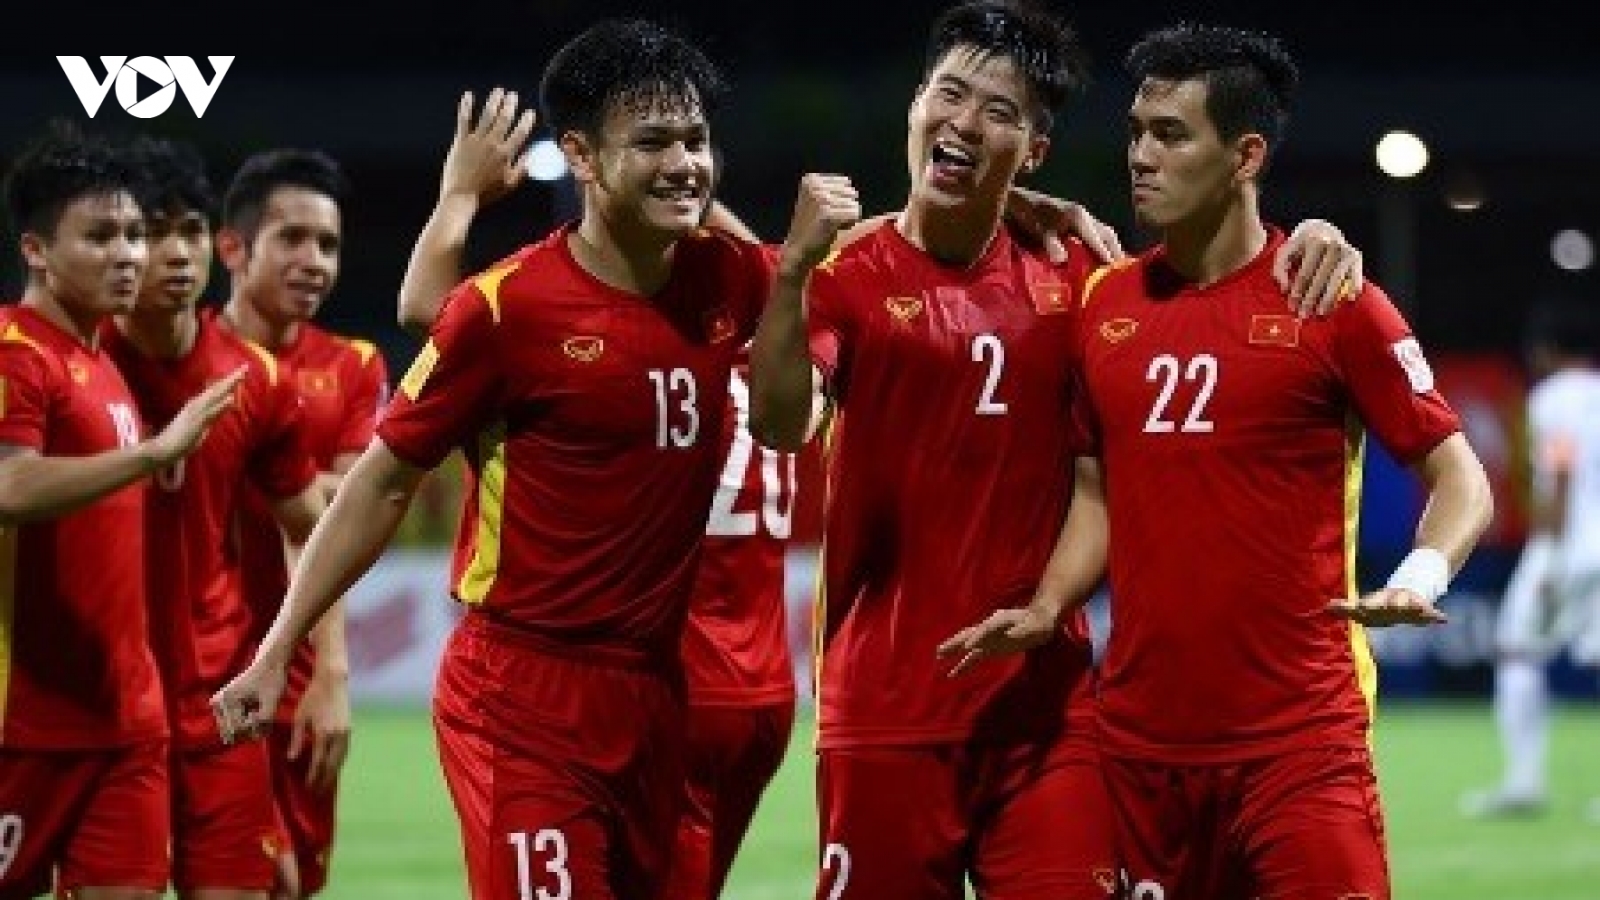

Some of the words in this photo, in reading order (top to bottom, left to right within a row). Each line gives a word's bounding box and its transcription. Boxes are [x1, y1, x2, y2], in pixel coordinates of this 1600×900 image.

[648, 368, 699, 449] 13
[972, 335, 1008, 414] 2
[1144, 353, 1218, 432] 22
[507, 828, 571, 900] 13
